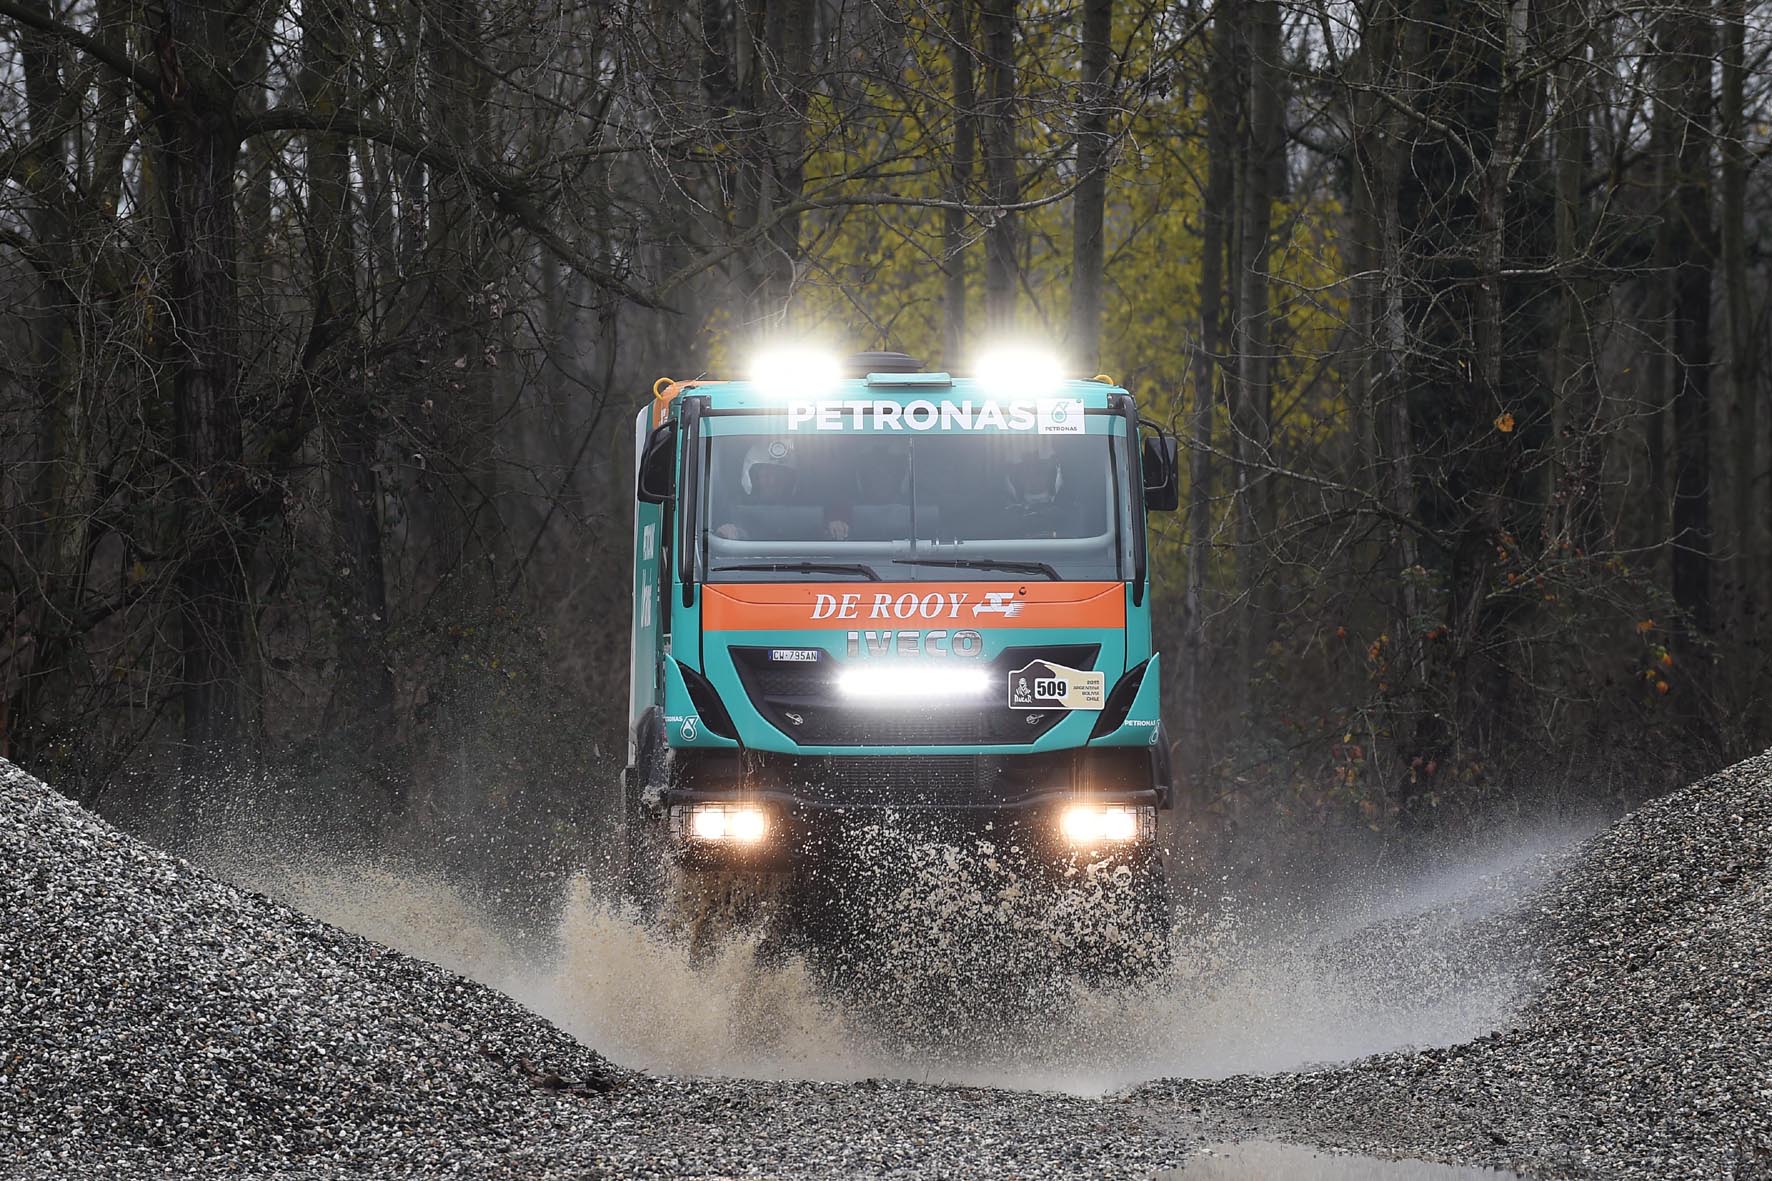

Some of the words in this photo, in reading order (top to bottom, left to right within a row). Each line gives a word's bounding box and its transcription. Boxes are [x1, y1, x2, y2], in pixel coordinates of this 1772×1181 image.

[788, 400, 1034, 430] PETRONAS
[810, 593, 861, 619] DE
[868, 593, 968, 619] ROOY
[846, 630, 983, 657] IVECO
[1014, 694, 1032, 703] DAKAR
[1037, 681, 1067, 696] 509
